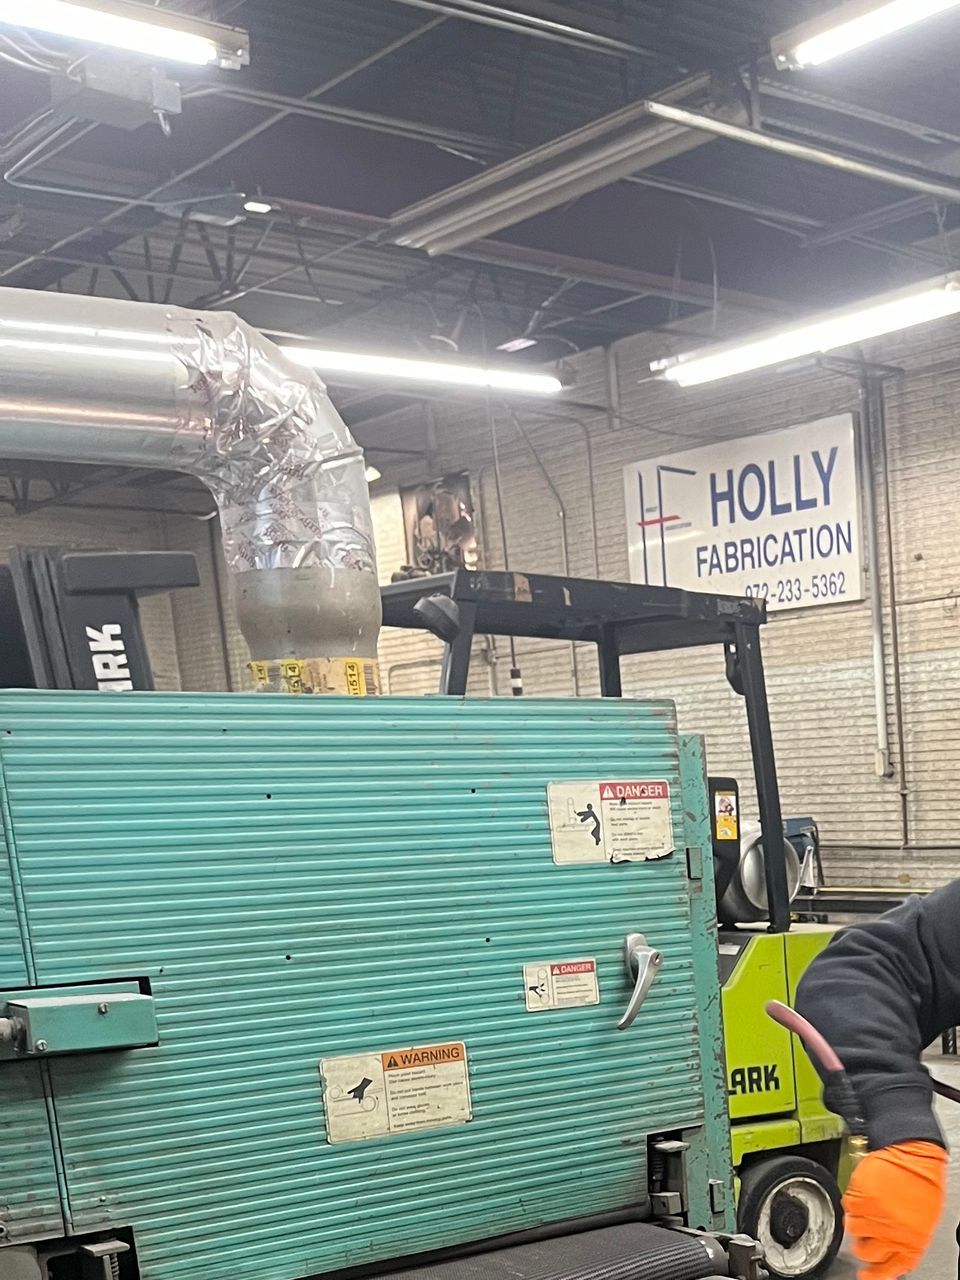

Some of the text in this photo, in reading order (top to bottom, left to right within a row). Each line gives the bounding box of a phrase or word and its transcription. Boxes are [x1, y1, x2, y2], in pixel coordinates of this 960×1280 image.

[709, 446, 838, 527] HOLLY
[696, 521, 852, 577] FABRICATION
[616, 785, 663, 797] DANGER
[560, 963, 592, 973] DANGER
[400, 1047, 460, 1065] WARNING
